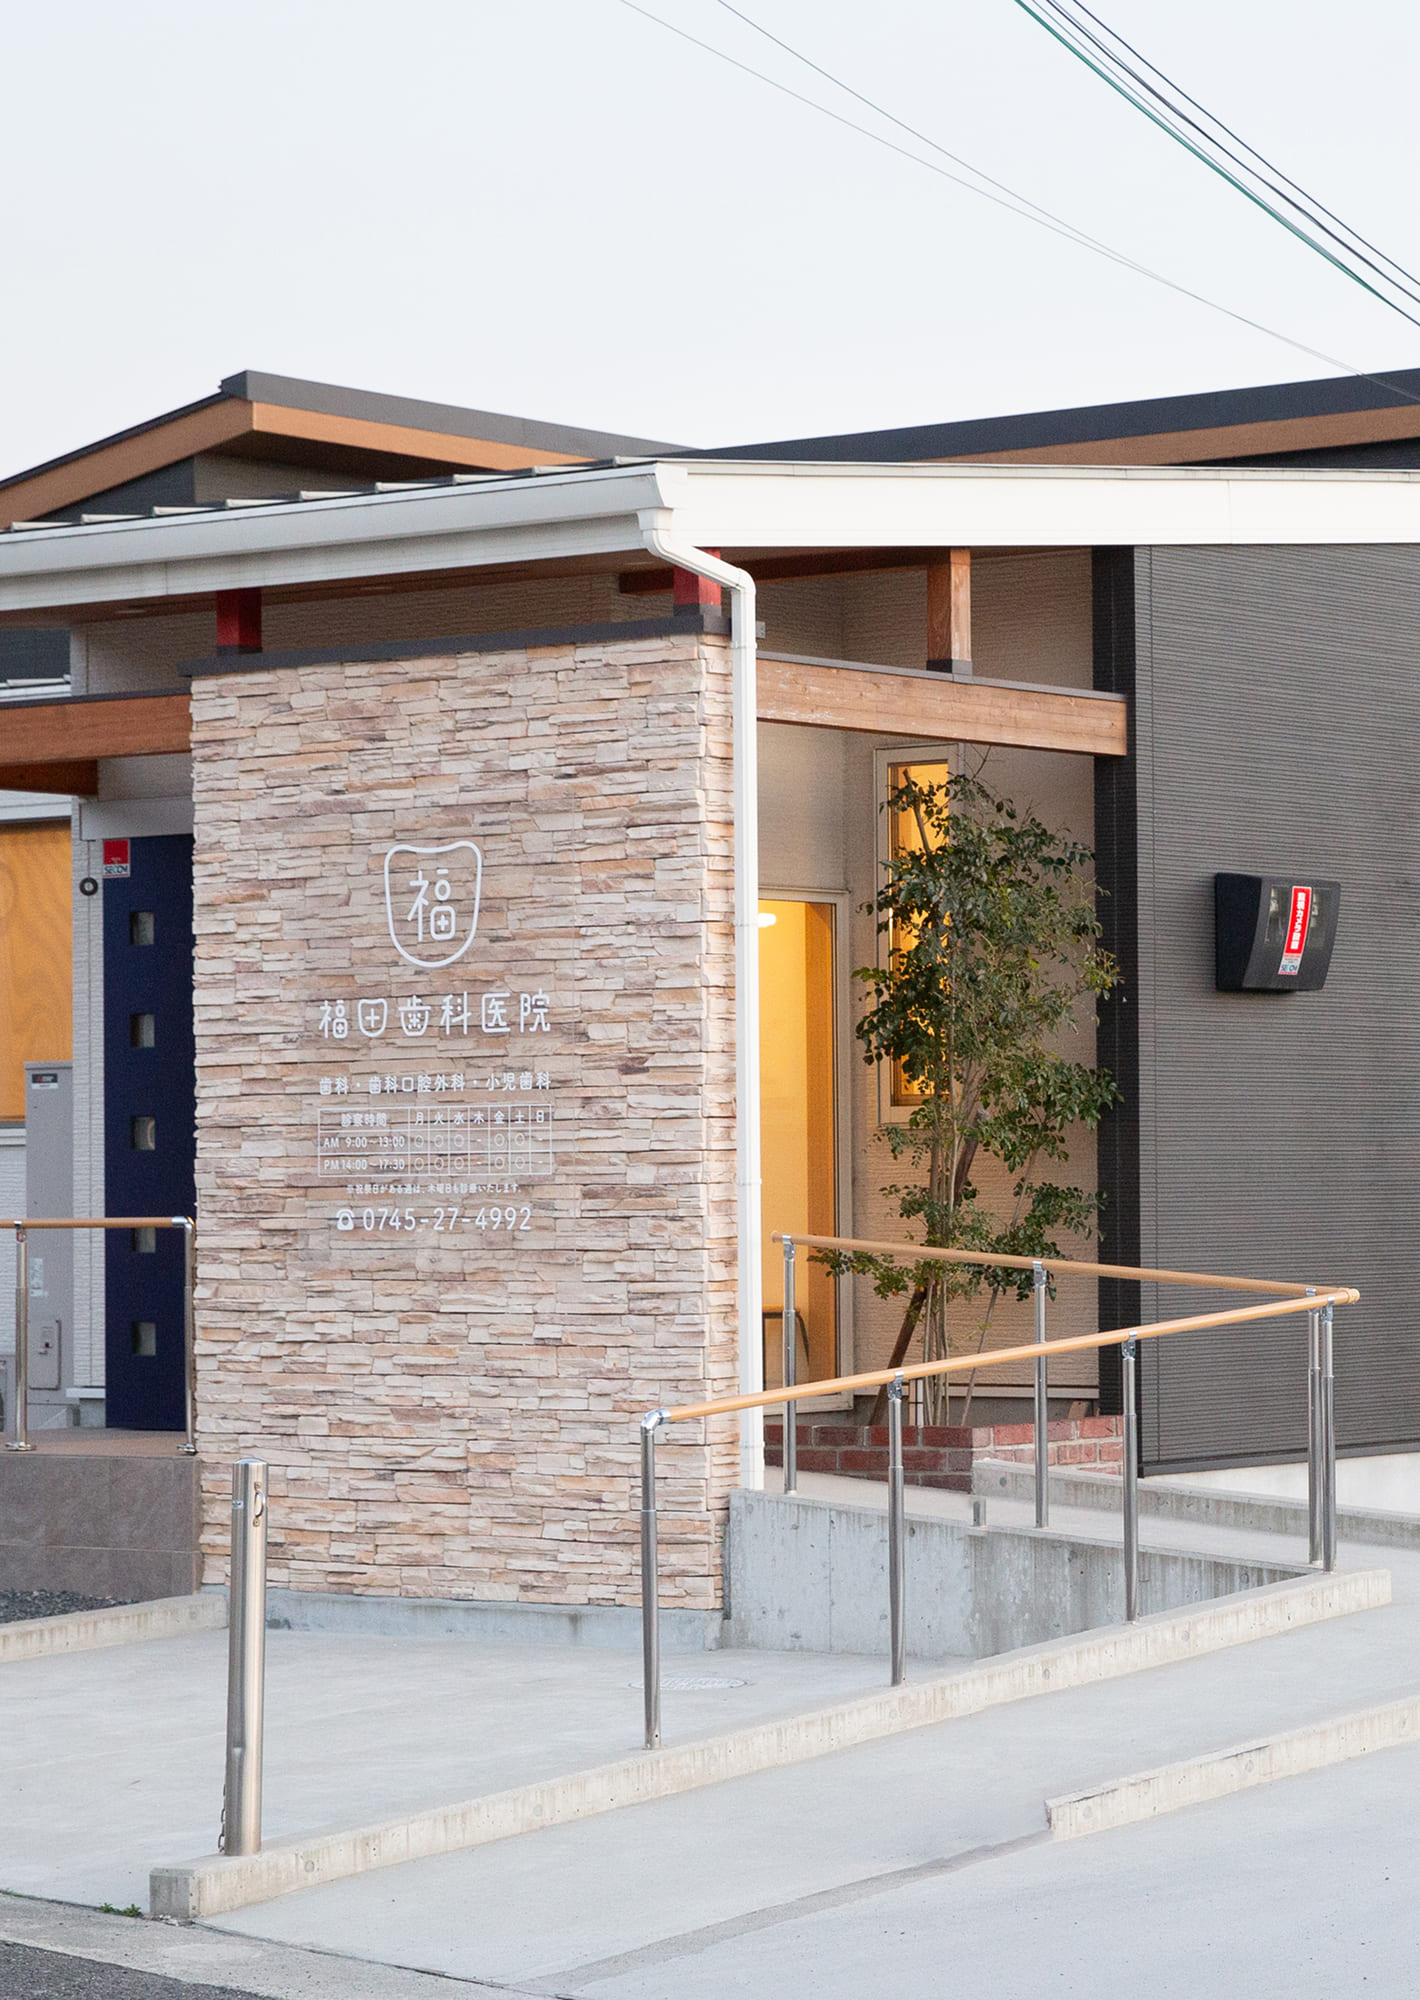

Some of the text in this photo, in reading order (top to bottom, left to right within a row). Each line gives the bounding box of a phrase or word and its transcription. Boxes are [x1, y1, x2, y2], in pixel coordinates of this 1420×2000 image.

[407, 869, 456, 942] 福
[319, 988, 551, 1039] 福田歯科医院
[414, 1111, 424, 1126] 月
[433, 1111, 445, 1125] 火
[453, 1111, 465, 1125] 水
[473, 1111, 485, 1125] 木
[494, 1110, 505, 1124] 金
[515, 1109, 526, 1124] 土
[536, 1109, 545, 1123] 日
[323, 1137, 340, 1148] AM
[323, 1159, 340, 1170] PM
[363, 1206, 532, 1231] 0745-27-4992
